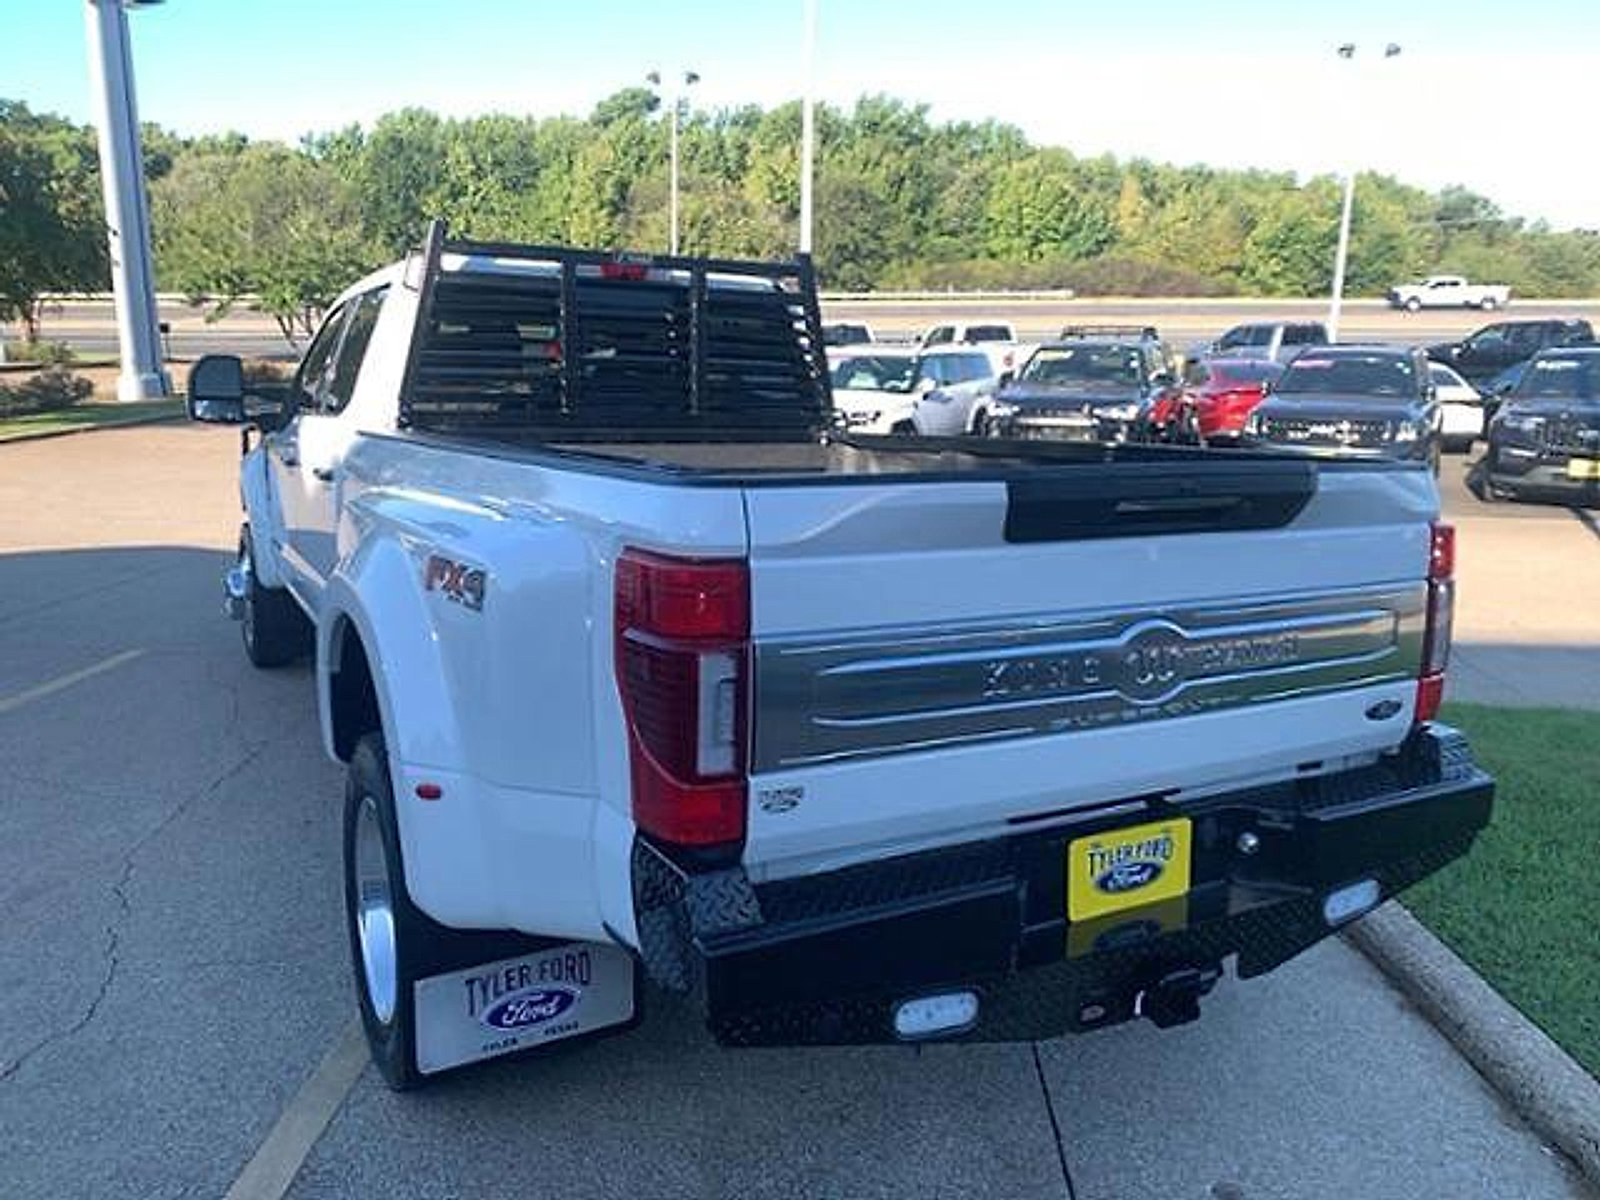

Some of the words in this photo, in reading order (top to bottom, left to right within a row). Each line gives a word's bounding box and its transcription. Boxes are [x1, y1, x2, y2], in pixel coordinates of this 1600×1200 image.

[464, 963, 531, 1017] TYLER
[540, 951, 592, 988] FORD
[499, 992, 567, 1026] Ford
